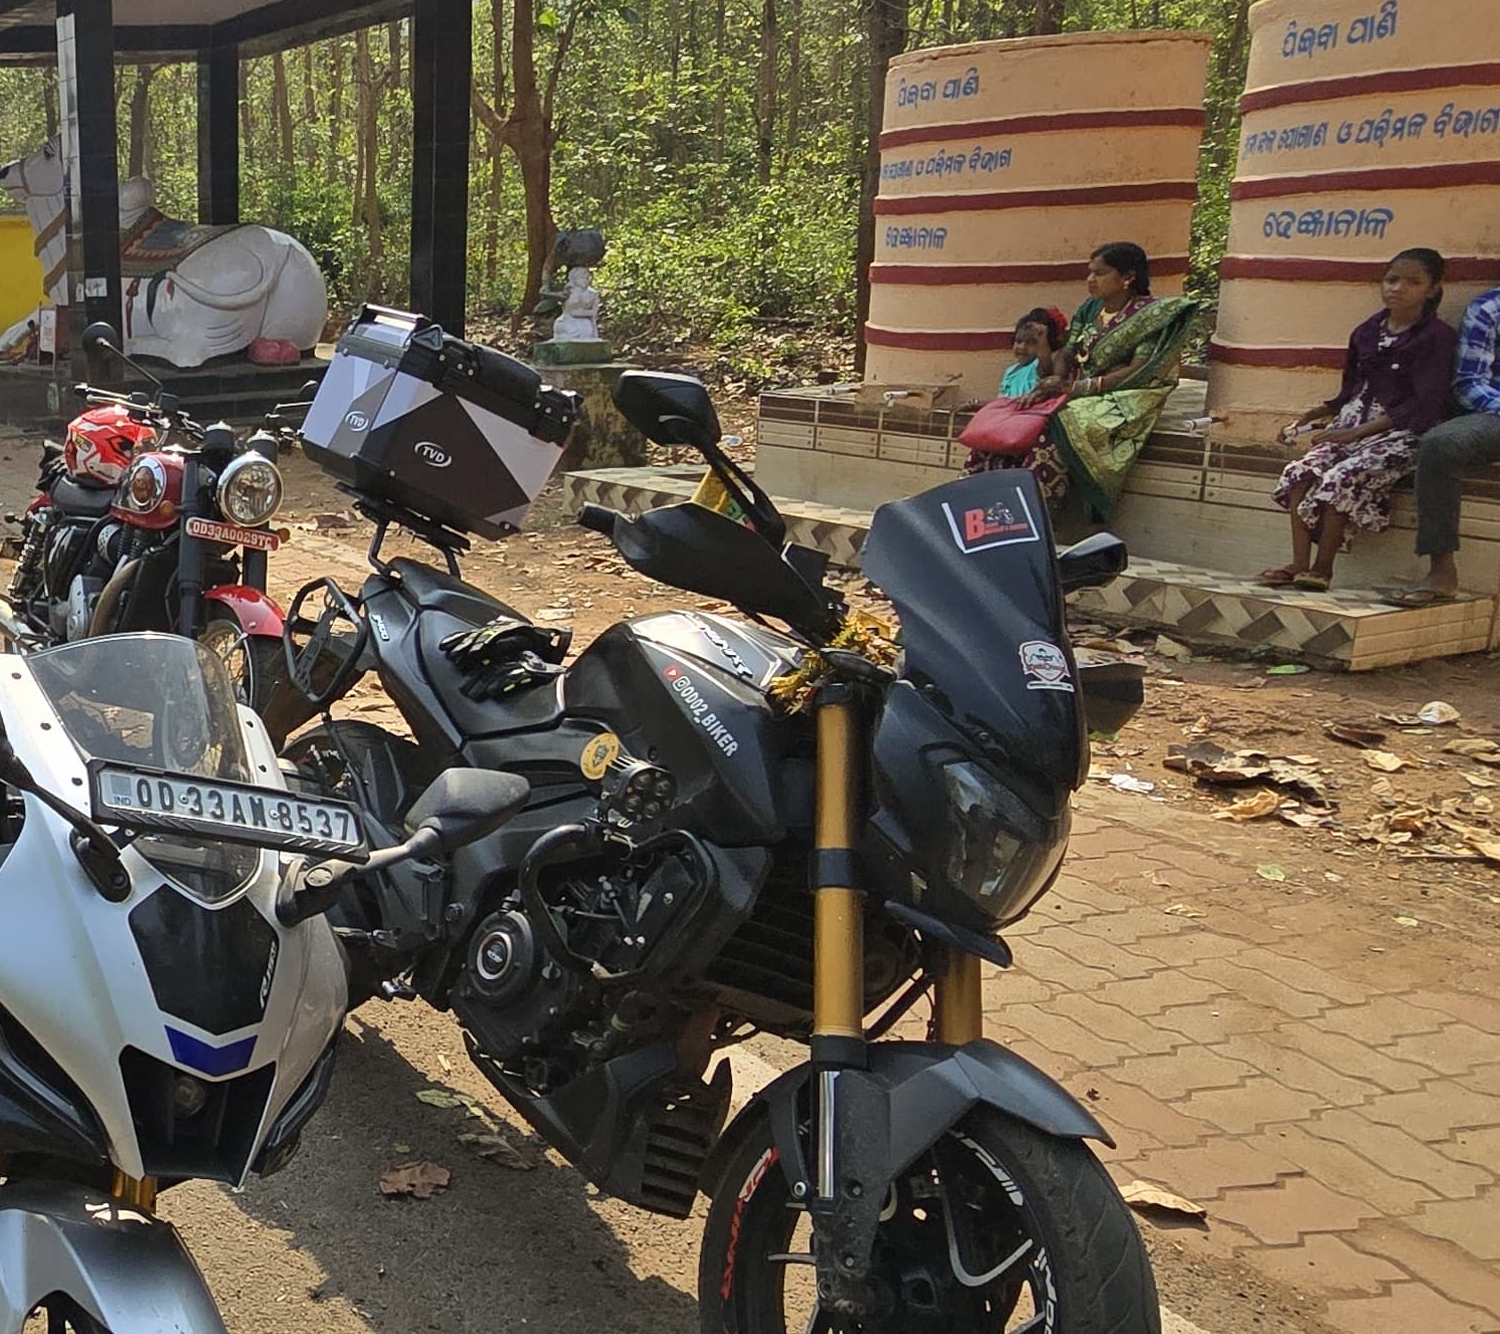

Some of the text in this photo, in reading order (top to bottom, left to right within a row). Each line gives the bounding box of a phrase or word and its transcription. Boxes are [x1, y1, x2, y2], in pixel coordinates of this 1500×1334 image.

[1347, 0, 1398, 45] ପାଣି
[942, 67, 980, 99] ପାଣି
[422, 445, 446, 464] TVD
